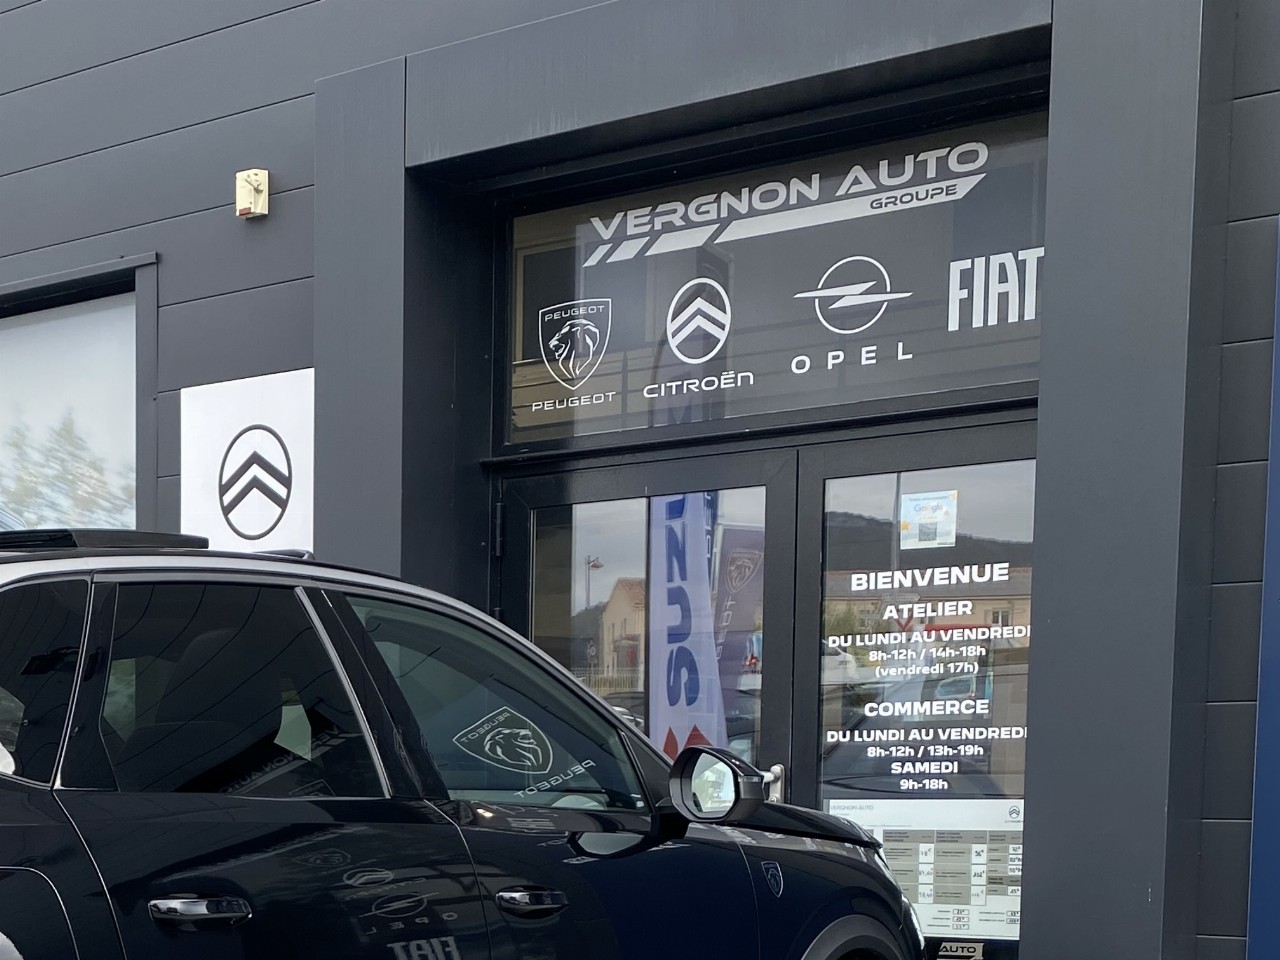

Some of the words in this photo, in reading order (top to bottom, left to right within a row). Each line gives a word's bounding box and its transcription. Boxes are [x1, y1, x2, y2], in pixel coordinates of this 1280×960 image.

[589, 172, 821, 241] VERGNON
[834, 141, 990, 198] AUTO
[869, 183, 959, 211] GROUPE
[947, 247, 1045, 332] FIAT
[544, 304, 606, 323] PEUGEOT
[791, 342, 913, 374] OPEL
[532, 391, 616, 412] PEUGEOT
[850, 562, 1010, 592] BIENVENUE
[882, 600, 973, 620] ATELIER
[828, 634, 852, 648] DU
[855, 631, 906, 646] LUNDI
[910, 629, 936, 644] AU
[868, 647, 916, 662] 8h-12h
[919, 648, 926, 660] /
[929, 645, 986, 659] 14h-18h
[875, 663, 944, 678] (vendredi
[947, 661, 979, 675] 17h)
[864, 699, 989, 718] COMMERCE
[826, 729, 851, 743] DU
[854, 728, 905, 742] LUNDI
[909, 727, 934, 741] AU
[867, 744, 914, 758] 8h-12h
[917, 745, 925, 757] /
[927, 743, 984, 757] 13h-19h
[890, 760, 959, 775] SAMEDI
[899, 777, 948, 791] 9h-18h
[939, 945, 976, 954] AUTO
